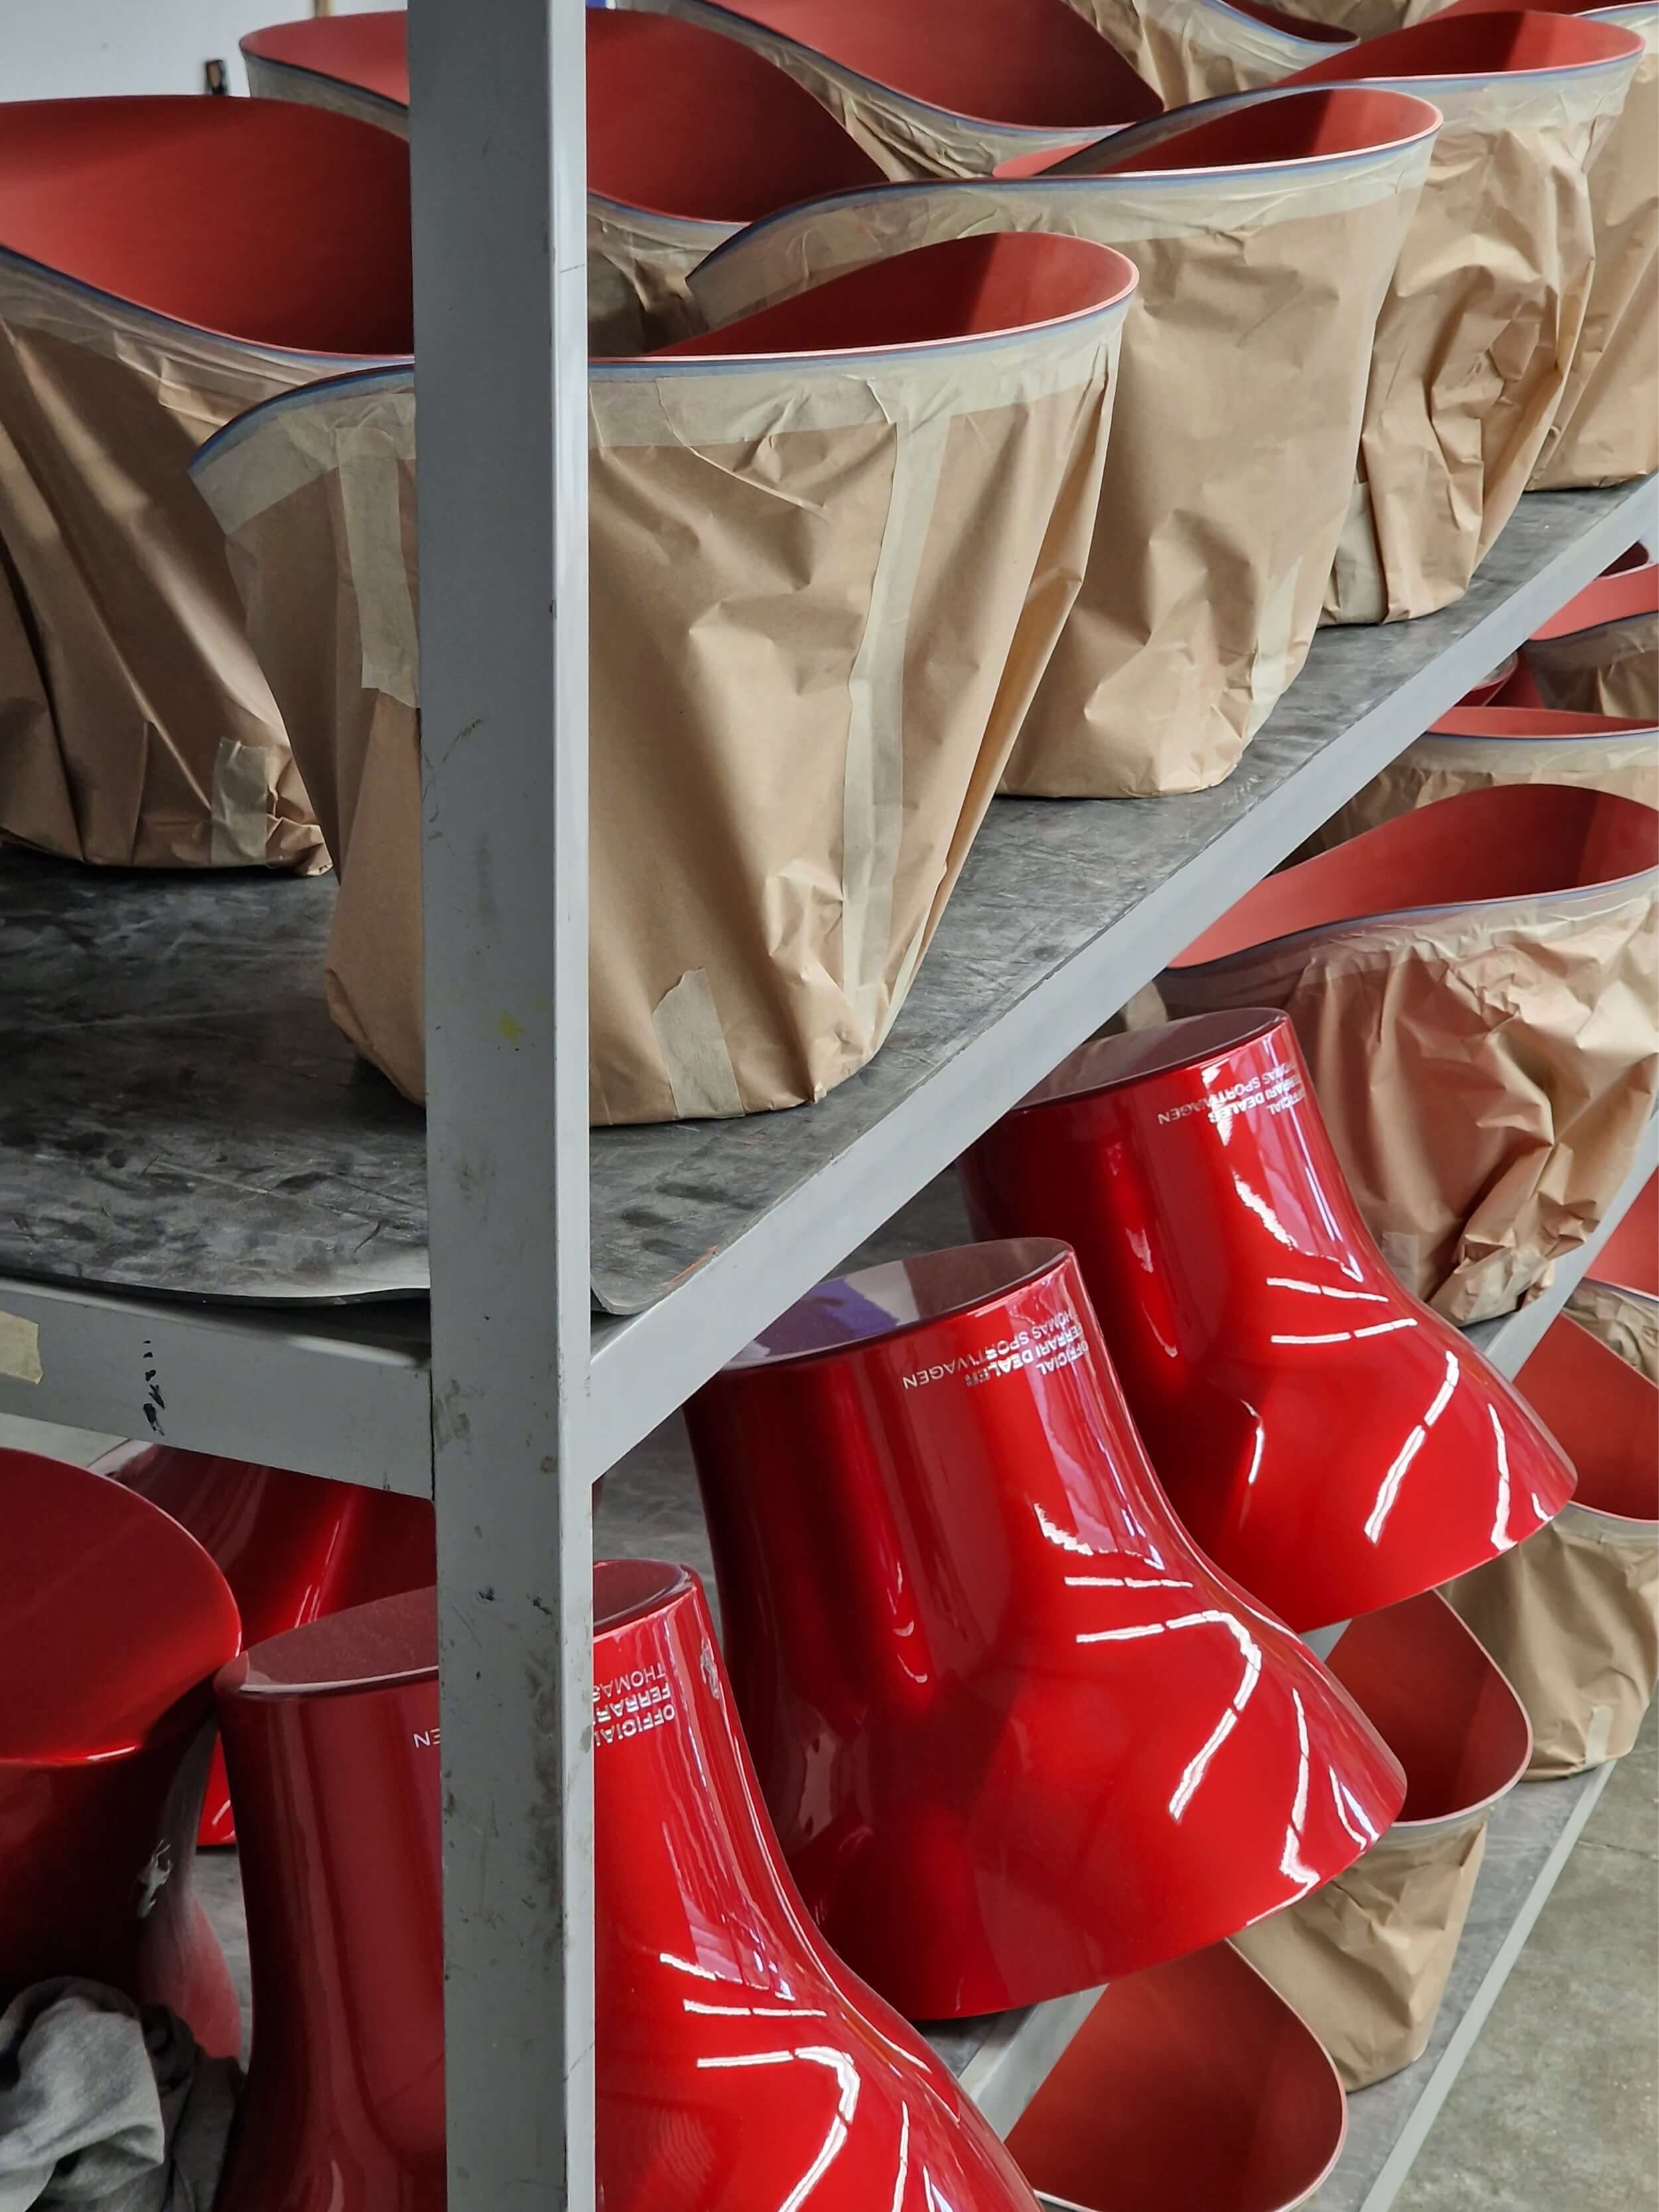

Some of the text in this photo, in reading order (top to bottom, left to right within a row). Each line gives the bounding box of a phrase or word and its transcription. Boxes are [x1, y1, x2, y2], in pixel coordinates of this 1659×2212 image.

[902, 1307, 1075, 1390] HOMAS SPORTWAGEN
[965, 1348, 1033, 1386] DEALER
[1035, 1340, 1088, 1375] OFFICIAL
[594, 1682, 672, 1726] FERRAR
